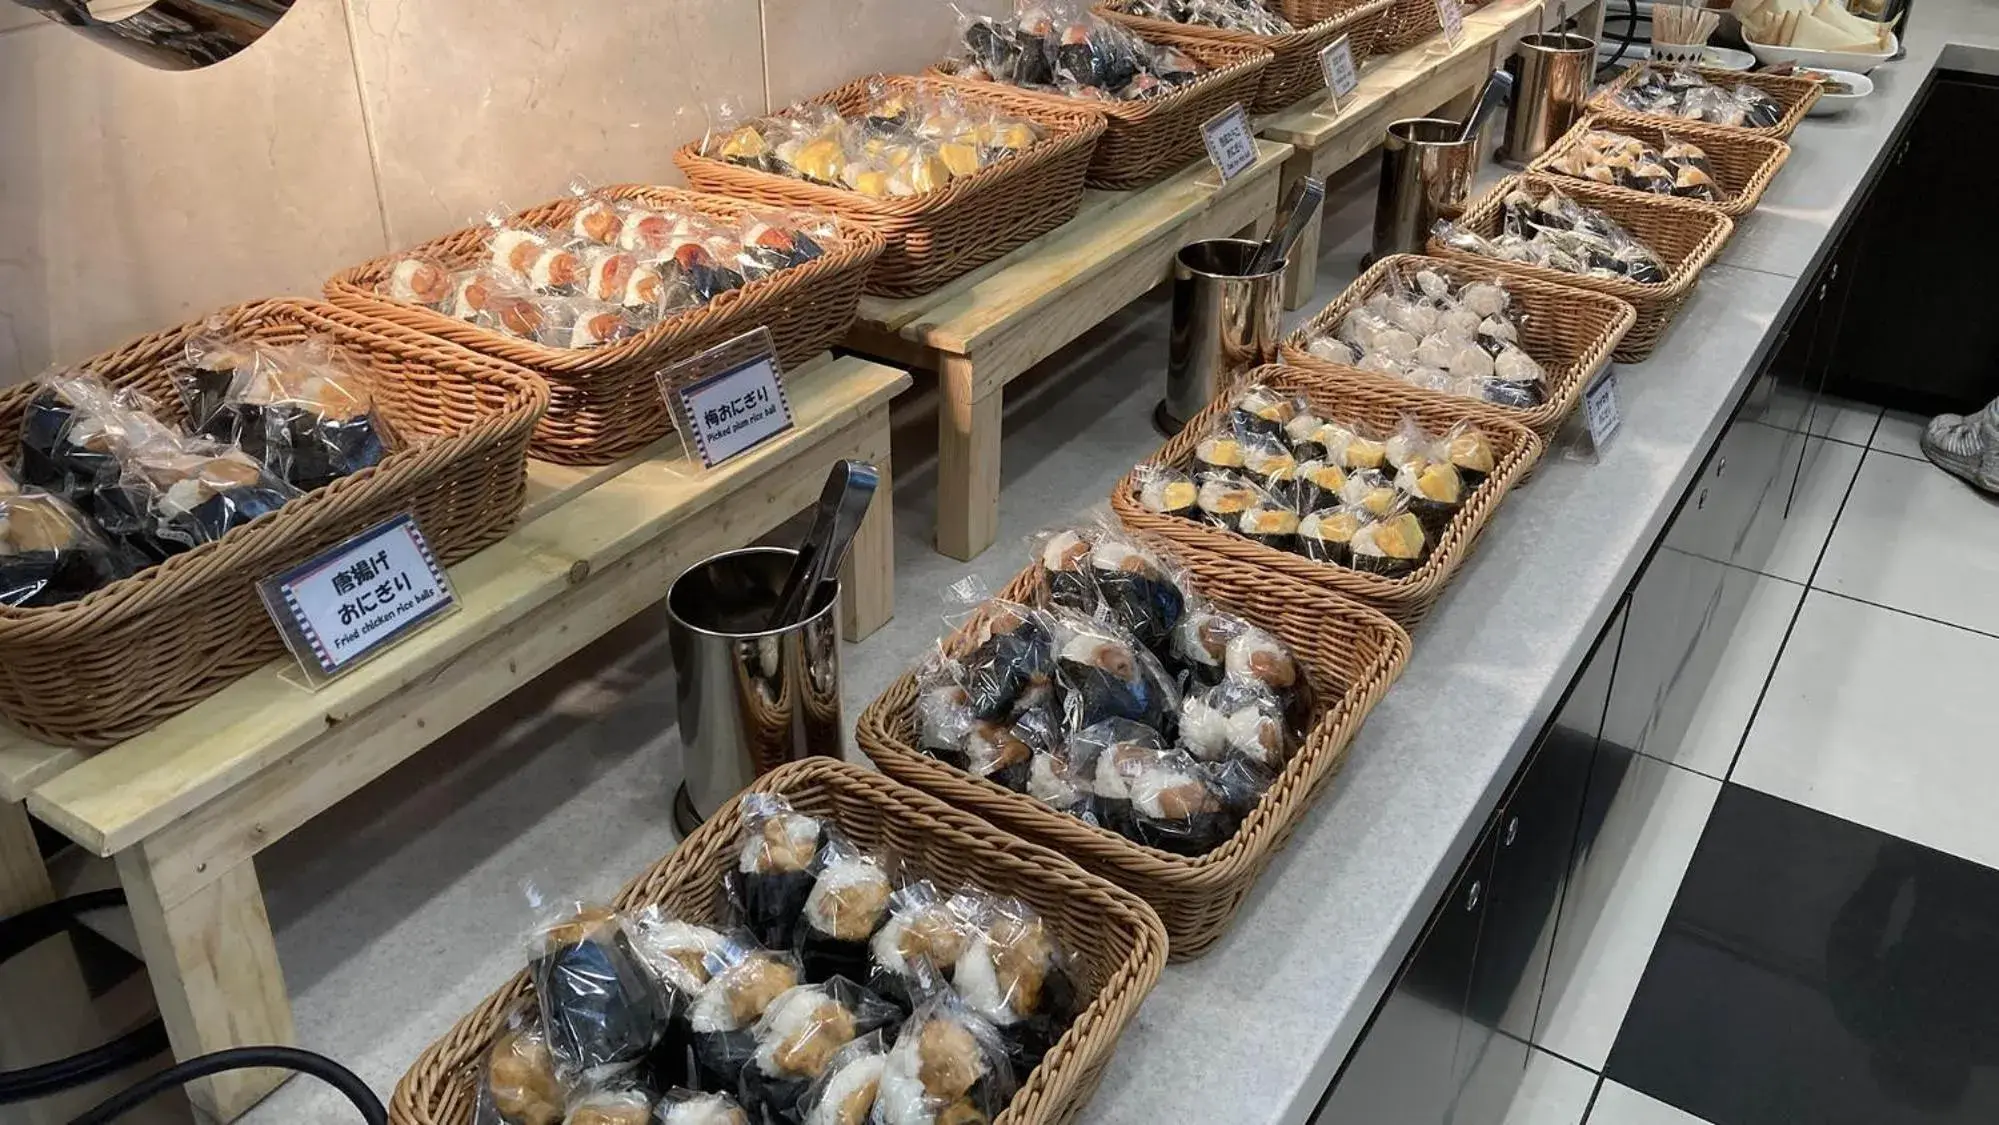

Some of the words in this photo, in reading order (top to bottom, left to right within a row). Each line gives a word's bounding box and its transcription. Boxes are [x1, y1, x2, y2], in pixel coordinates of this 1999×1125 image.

[704, 386, 769, 429] 梅おにぎり
[732, 418, 749, 433] plum
[750, 412, 764, 425] rice
[764, 404, 777, 418] ball
[331, 550, 391, 596] 唐揚げ
[334, 629, 360, 649] Fried
[361, 610, 396, 634] chicken
[396, 599, 414, 616] rice
[415, 588, 435, 604] balls
[338, 572, 412, 626] おにぎり
